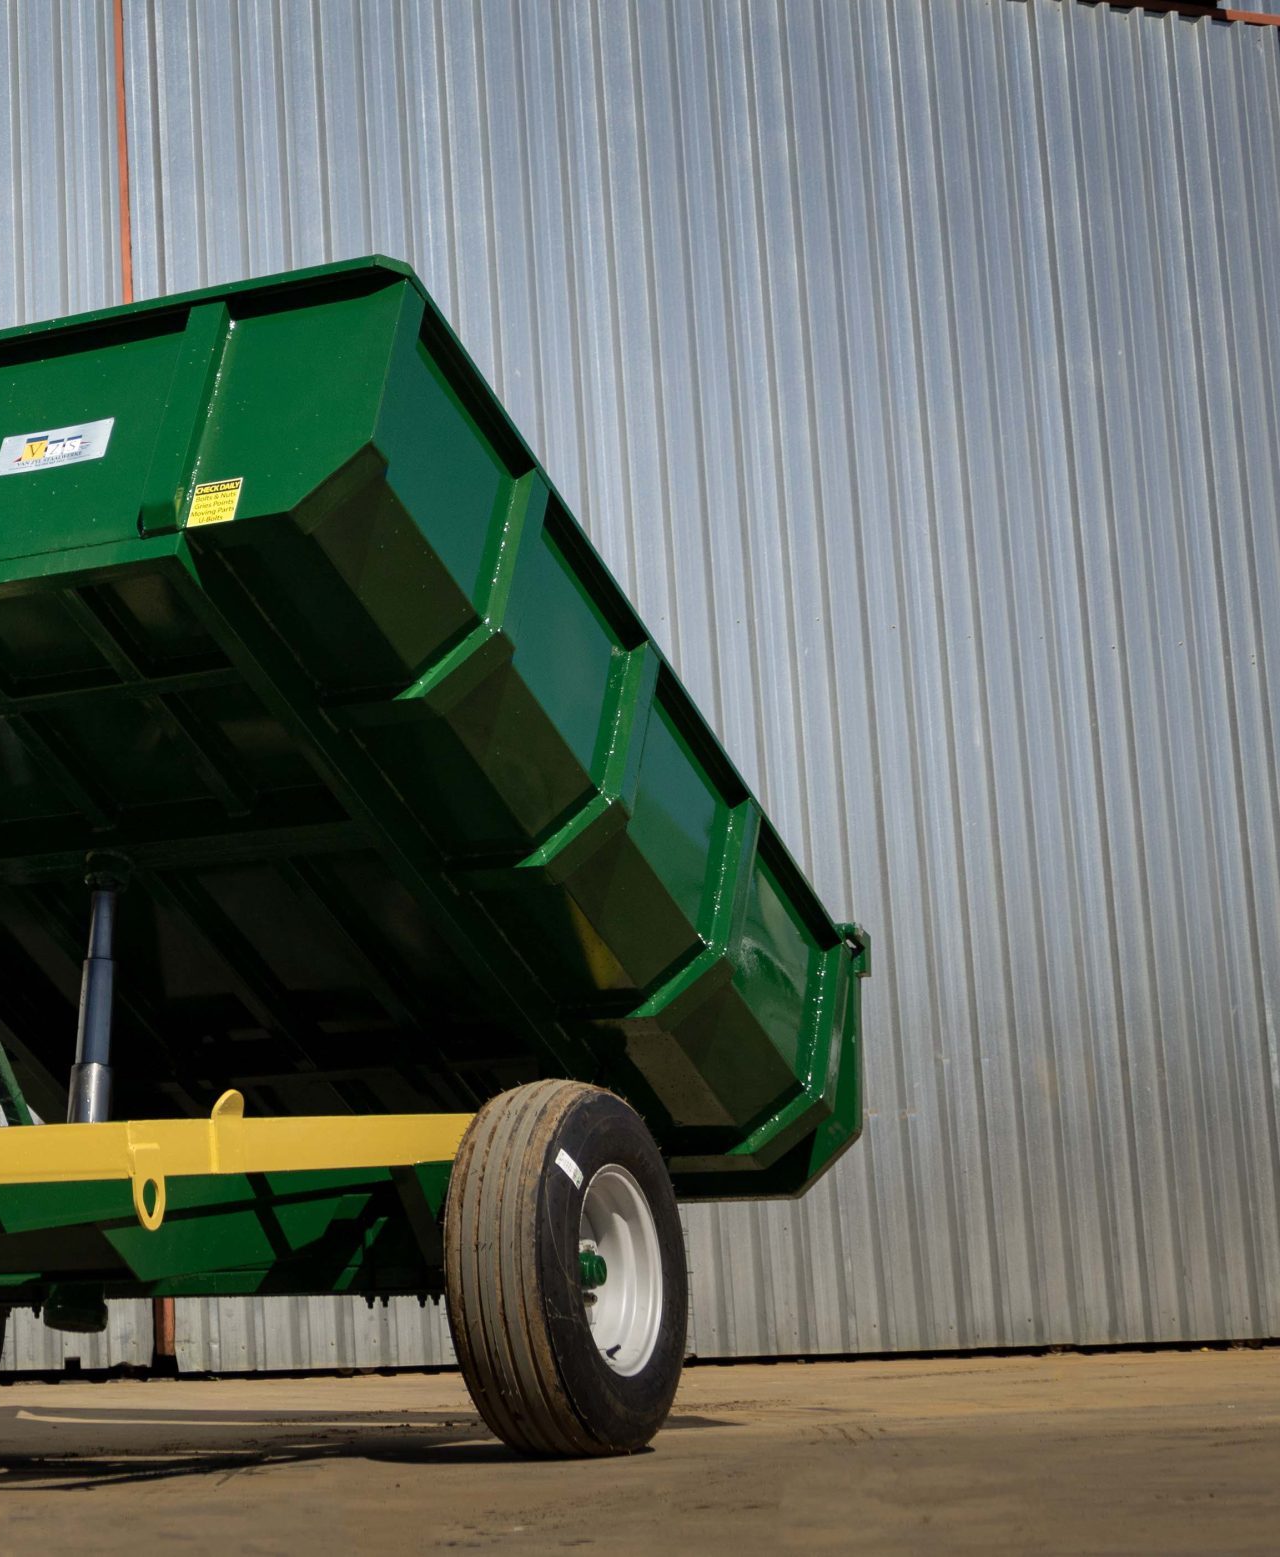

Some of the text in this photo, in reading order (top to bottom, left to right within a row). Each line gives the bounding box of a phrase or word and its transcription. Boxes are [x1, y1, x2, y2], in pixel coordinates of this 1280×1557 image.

[196, 481, 240, 494] CHECK DAILY
[198, 515, 223, 523] U-Bolts
